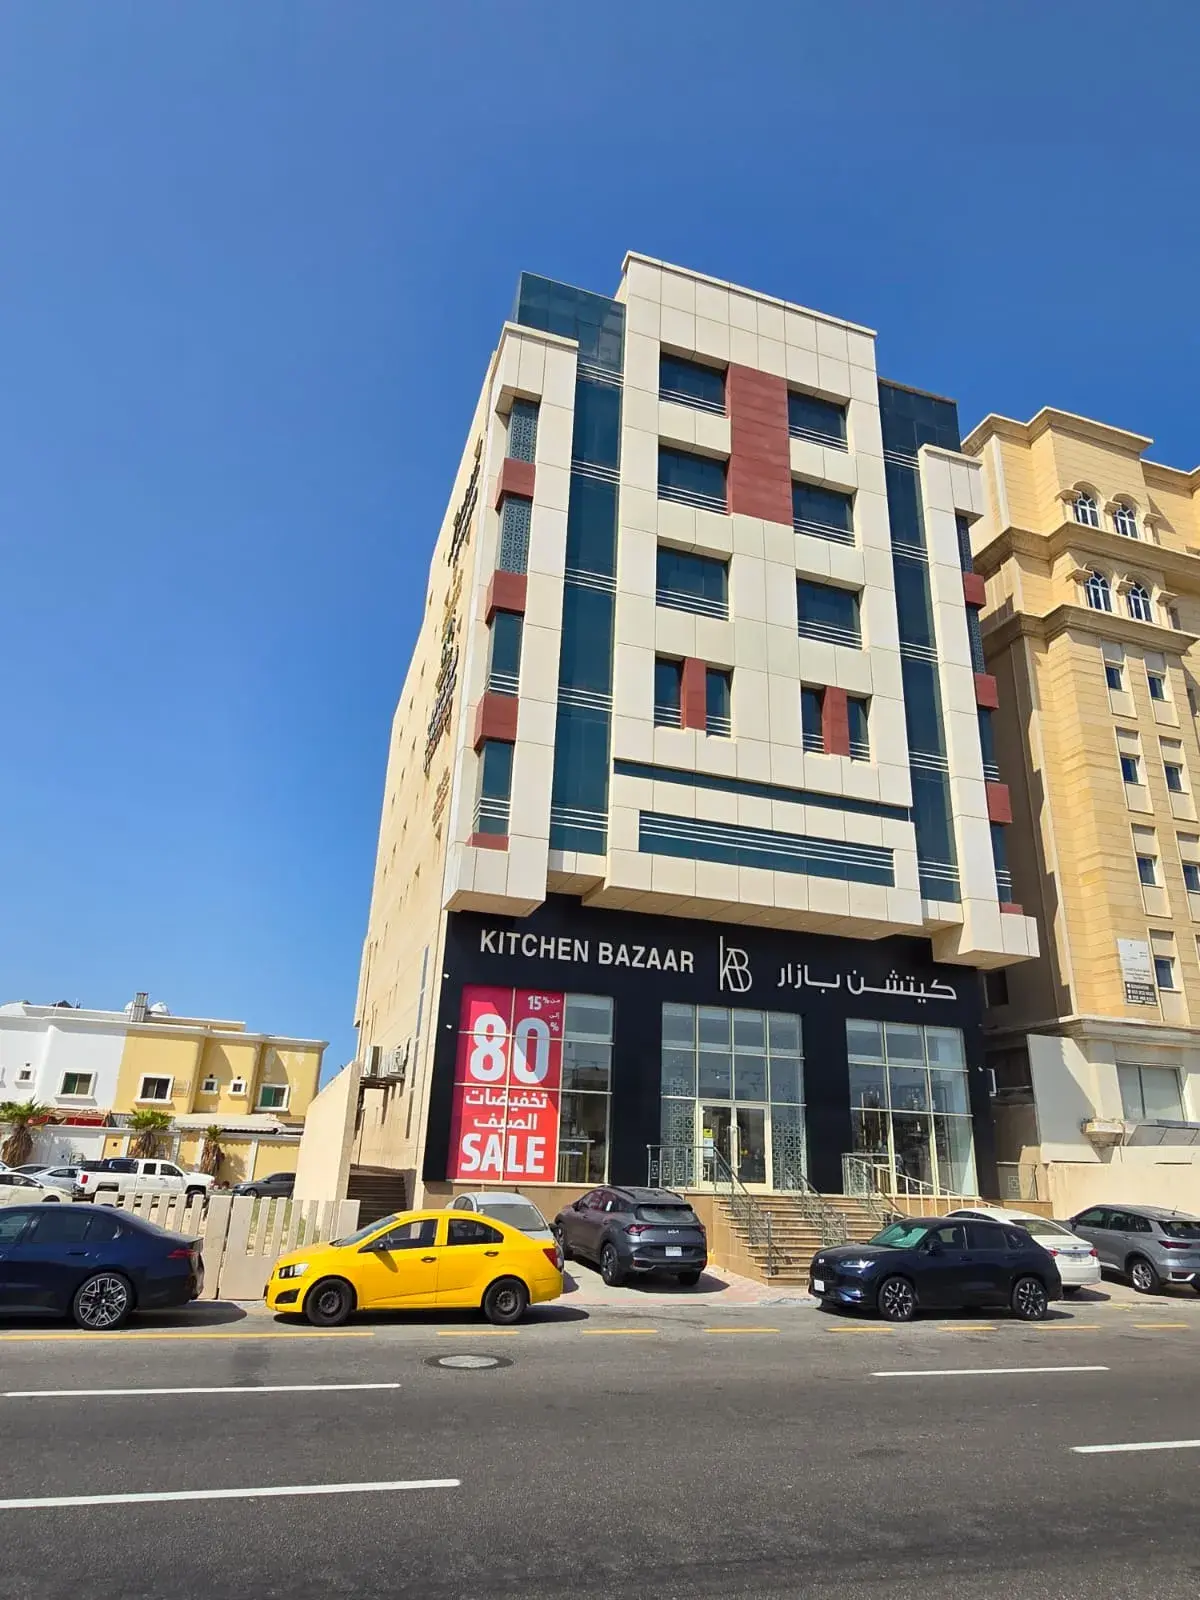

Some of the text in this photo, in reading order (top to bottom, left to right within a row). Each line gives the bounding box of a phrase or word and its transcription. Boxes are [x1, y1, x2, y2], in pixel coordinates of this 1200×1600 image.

[480, 929, 694, 974] KITCHEN BAZAAR
[777, 963, 957, 1004] كيتشن بازار
[465, 1088, 548, 1111] تخفيضات
[473, 1112, 538, 1134] الصيف
[461, 1133, 546, 1173] SALE
